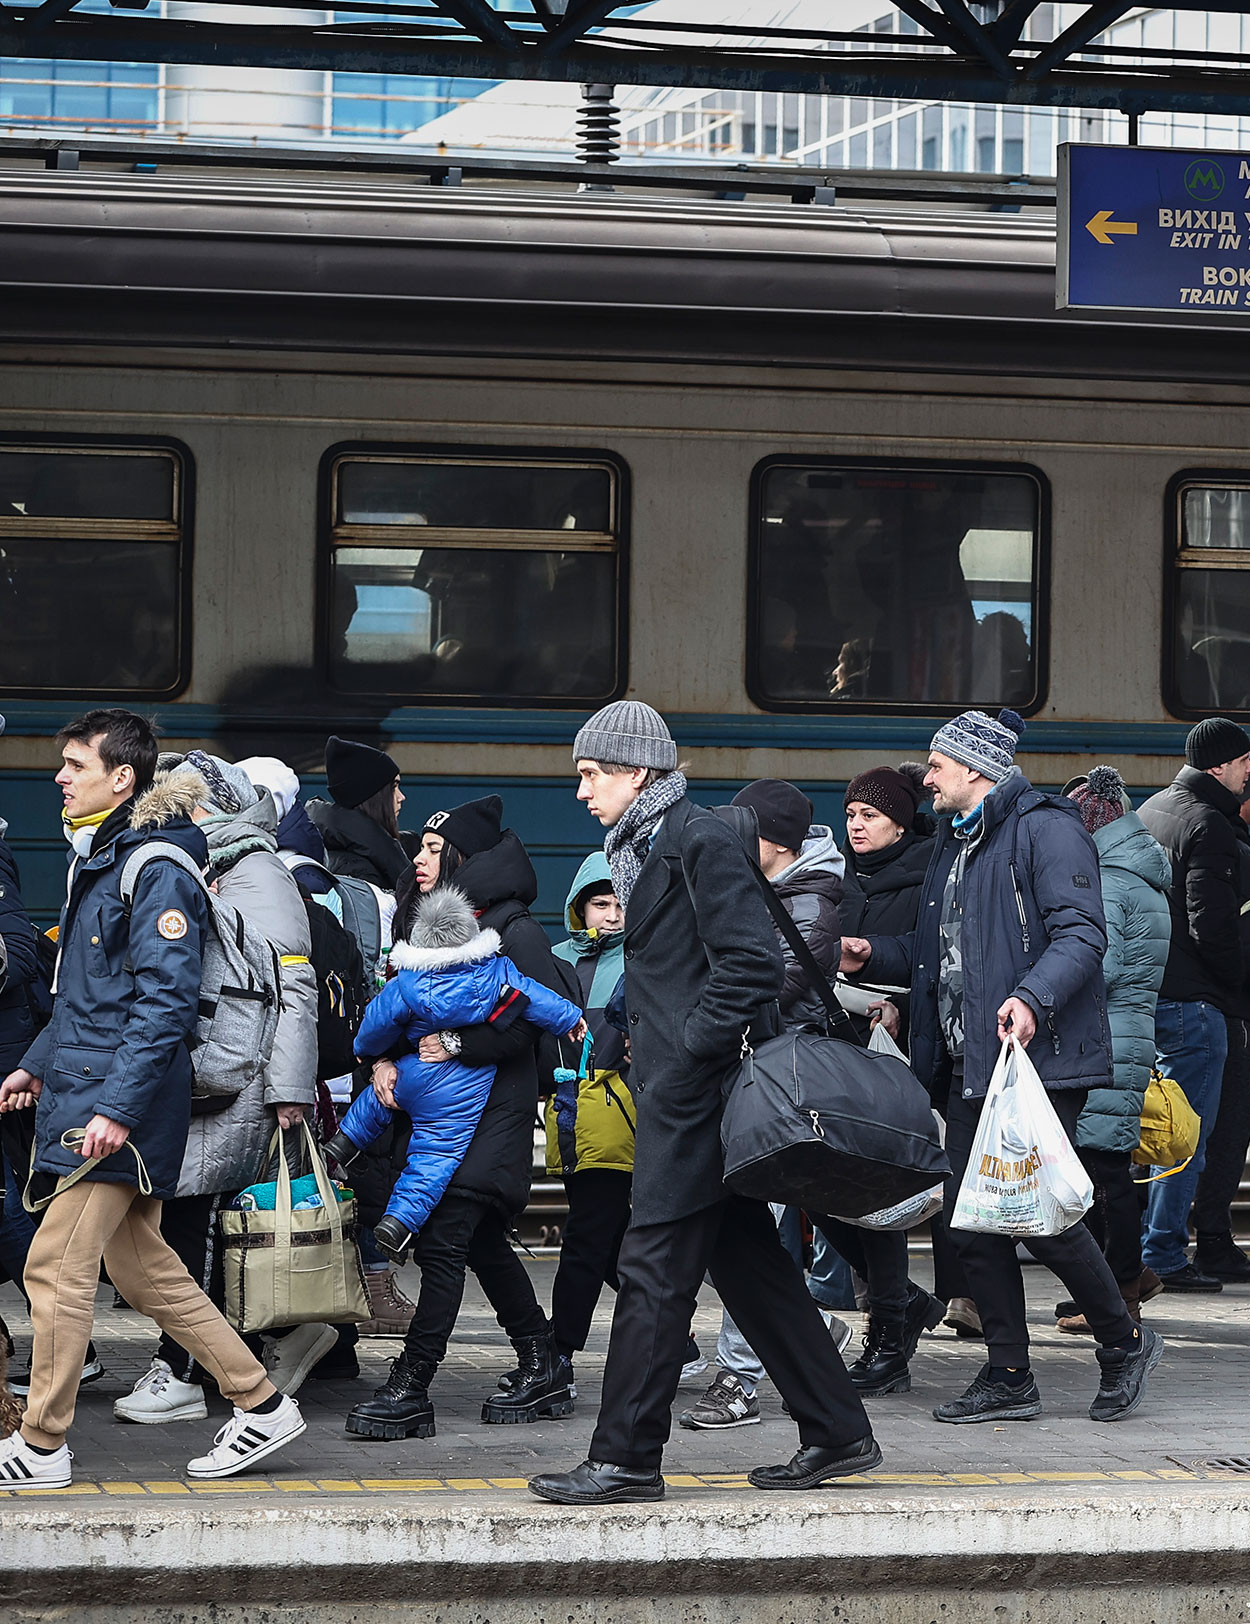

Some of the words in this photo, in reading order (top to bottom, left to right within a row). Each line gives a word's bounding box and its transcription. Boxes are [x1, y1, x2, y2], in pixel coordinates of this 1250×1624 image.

[1158, 208, 1237, 234] ВИХІД
[1169, 231, 1214, 250] EXIT
[1217, 234, 1242, 251] IN
[1179, 287, 1239, 306] TRAIN
